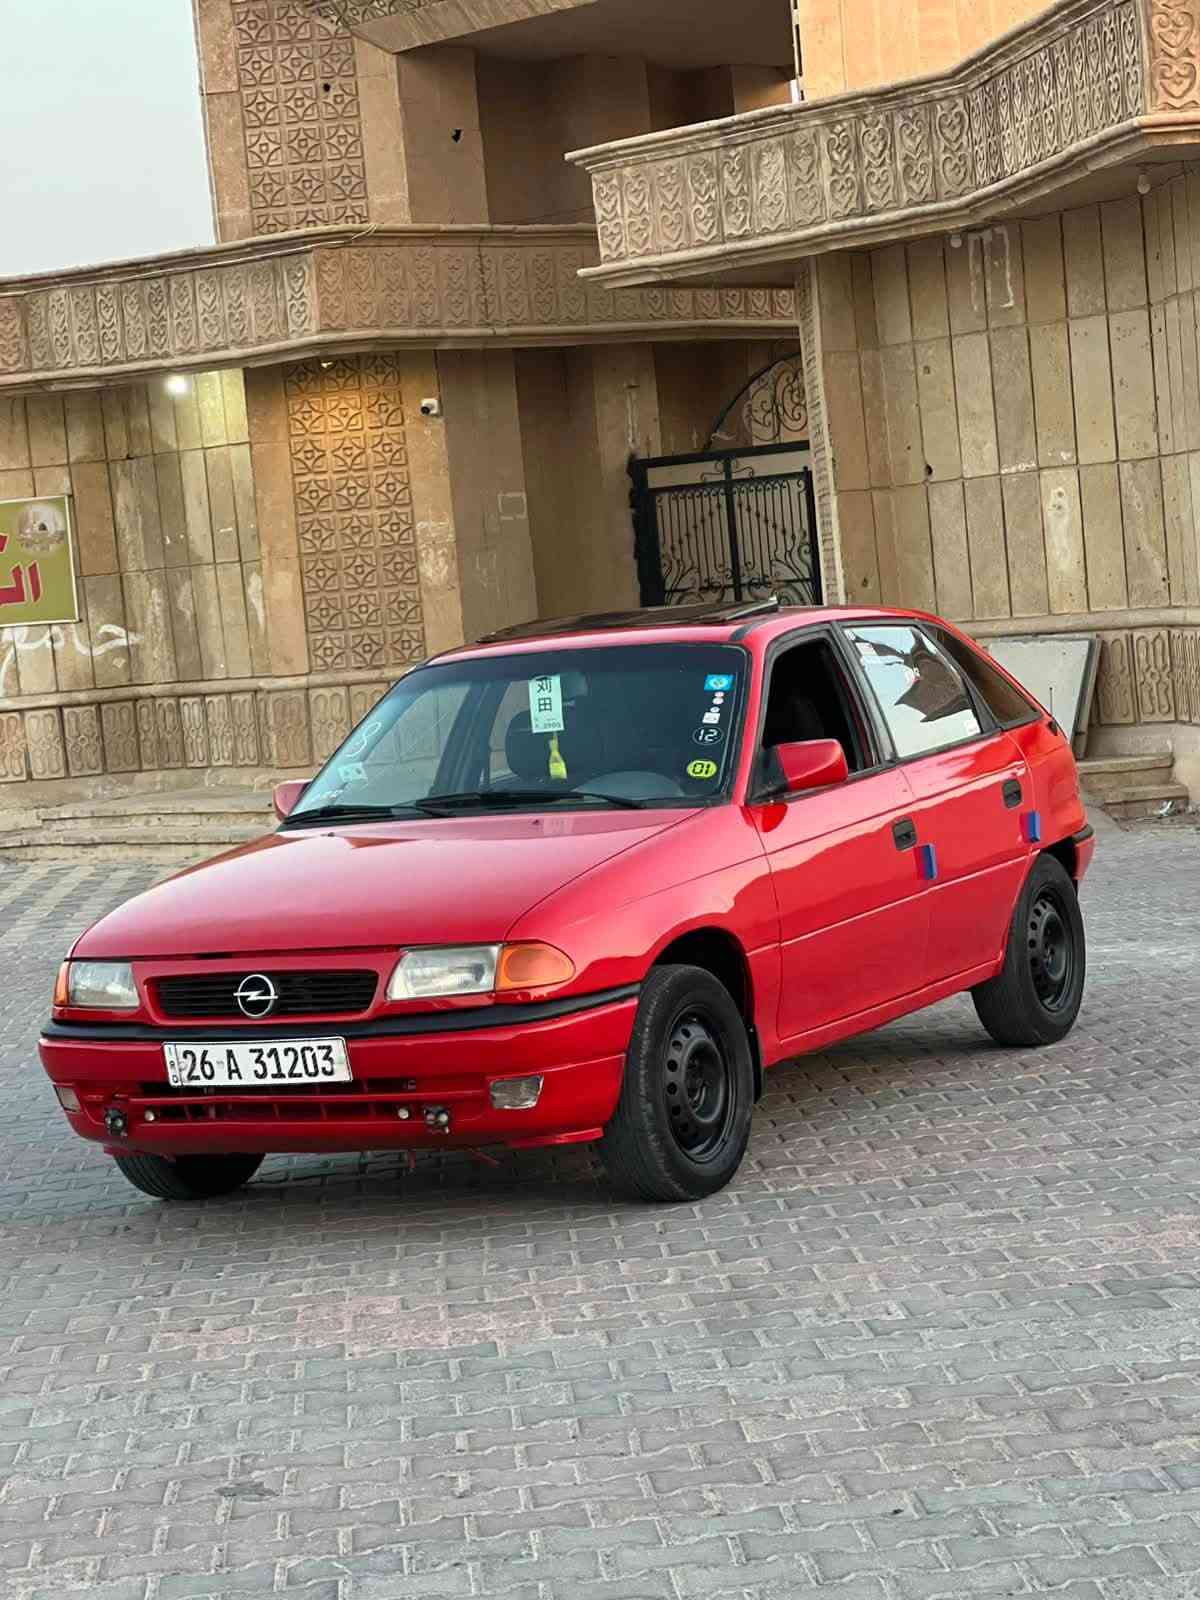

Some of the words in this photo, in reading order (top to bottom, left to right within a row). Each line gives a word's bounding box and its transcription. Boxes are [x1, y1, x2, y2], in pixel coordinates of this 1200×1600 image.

[698, 728, 719, 742] 12
[182, 1049, 215, 1081] 26
[226, 1048, 243, 1080] A
[249, 1045, 335, 1079] 31203
